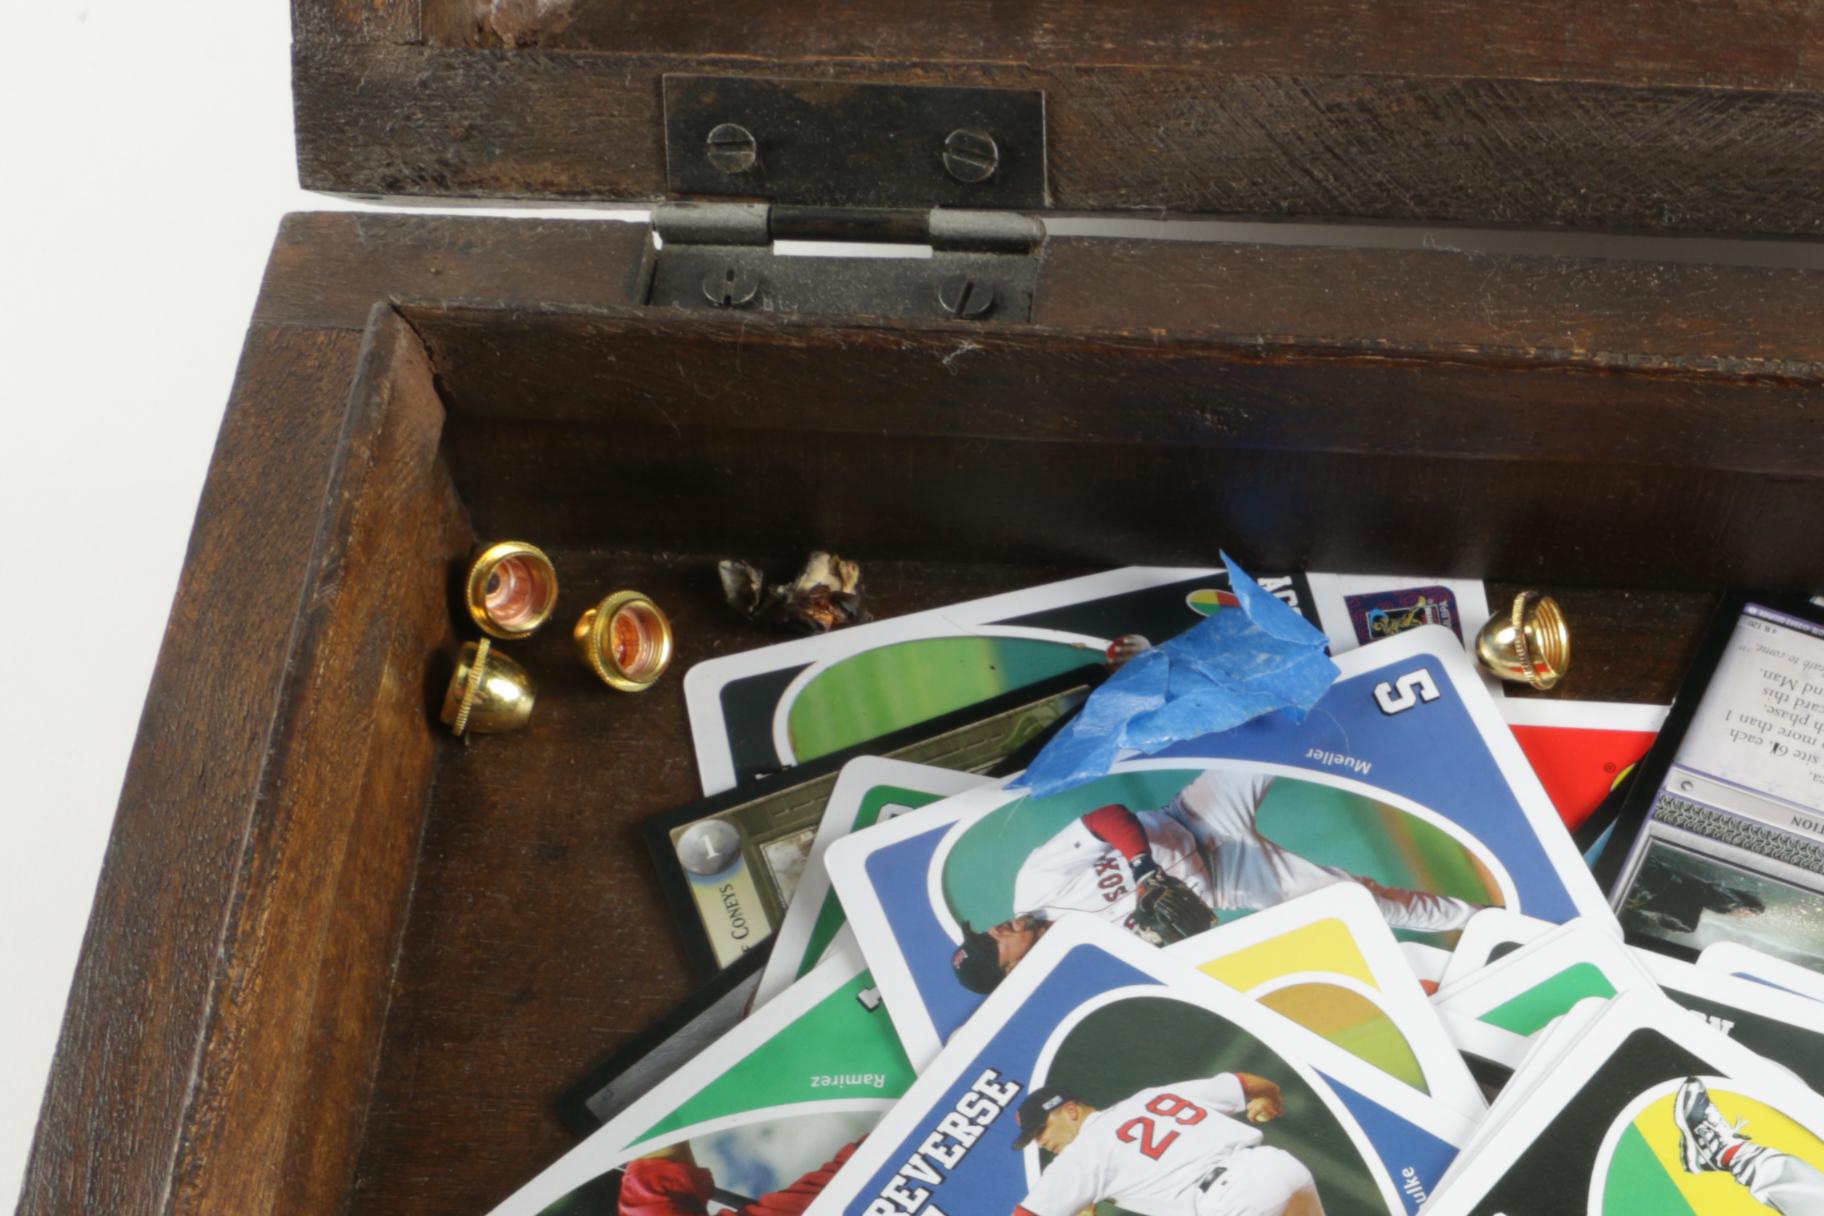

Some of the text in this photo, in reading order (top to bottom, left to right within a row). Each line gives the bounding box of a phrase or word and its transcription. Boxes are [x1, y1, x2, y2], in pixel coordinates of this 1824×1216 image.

[1788, 656, 1800, 664] to
[1760, 669, 1798, 691] Man.
[1373, 667, 1441, 716] 5
[1763, 688, 1790, 704] this
[1739, 714, 1773, 733] than
[1764, 704, 1811, 726] phase.
[1730, 728, 1764, 745] each
[1778, 727, 1817, 746] more
[1305, 746, 1372, 775] Mueller
[1793, 750, 1820, 764] site
[810, 1072, 886, 1090] Ramirez
[1115, 1092, 1208, 1161] 29
[1401, 1164, 1430, 1206] ulke
